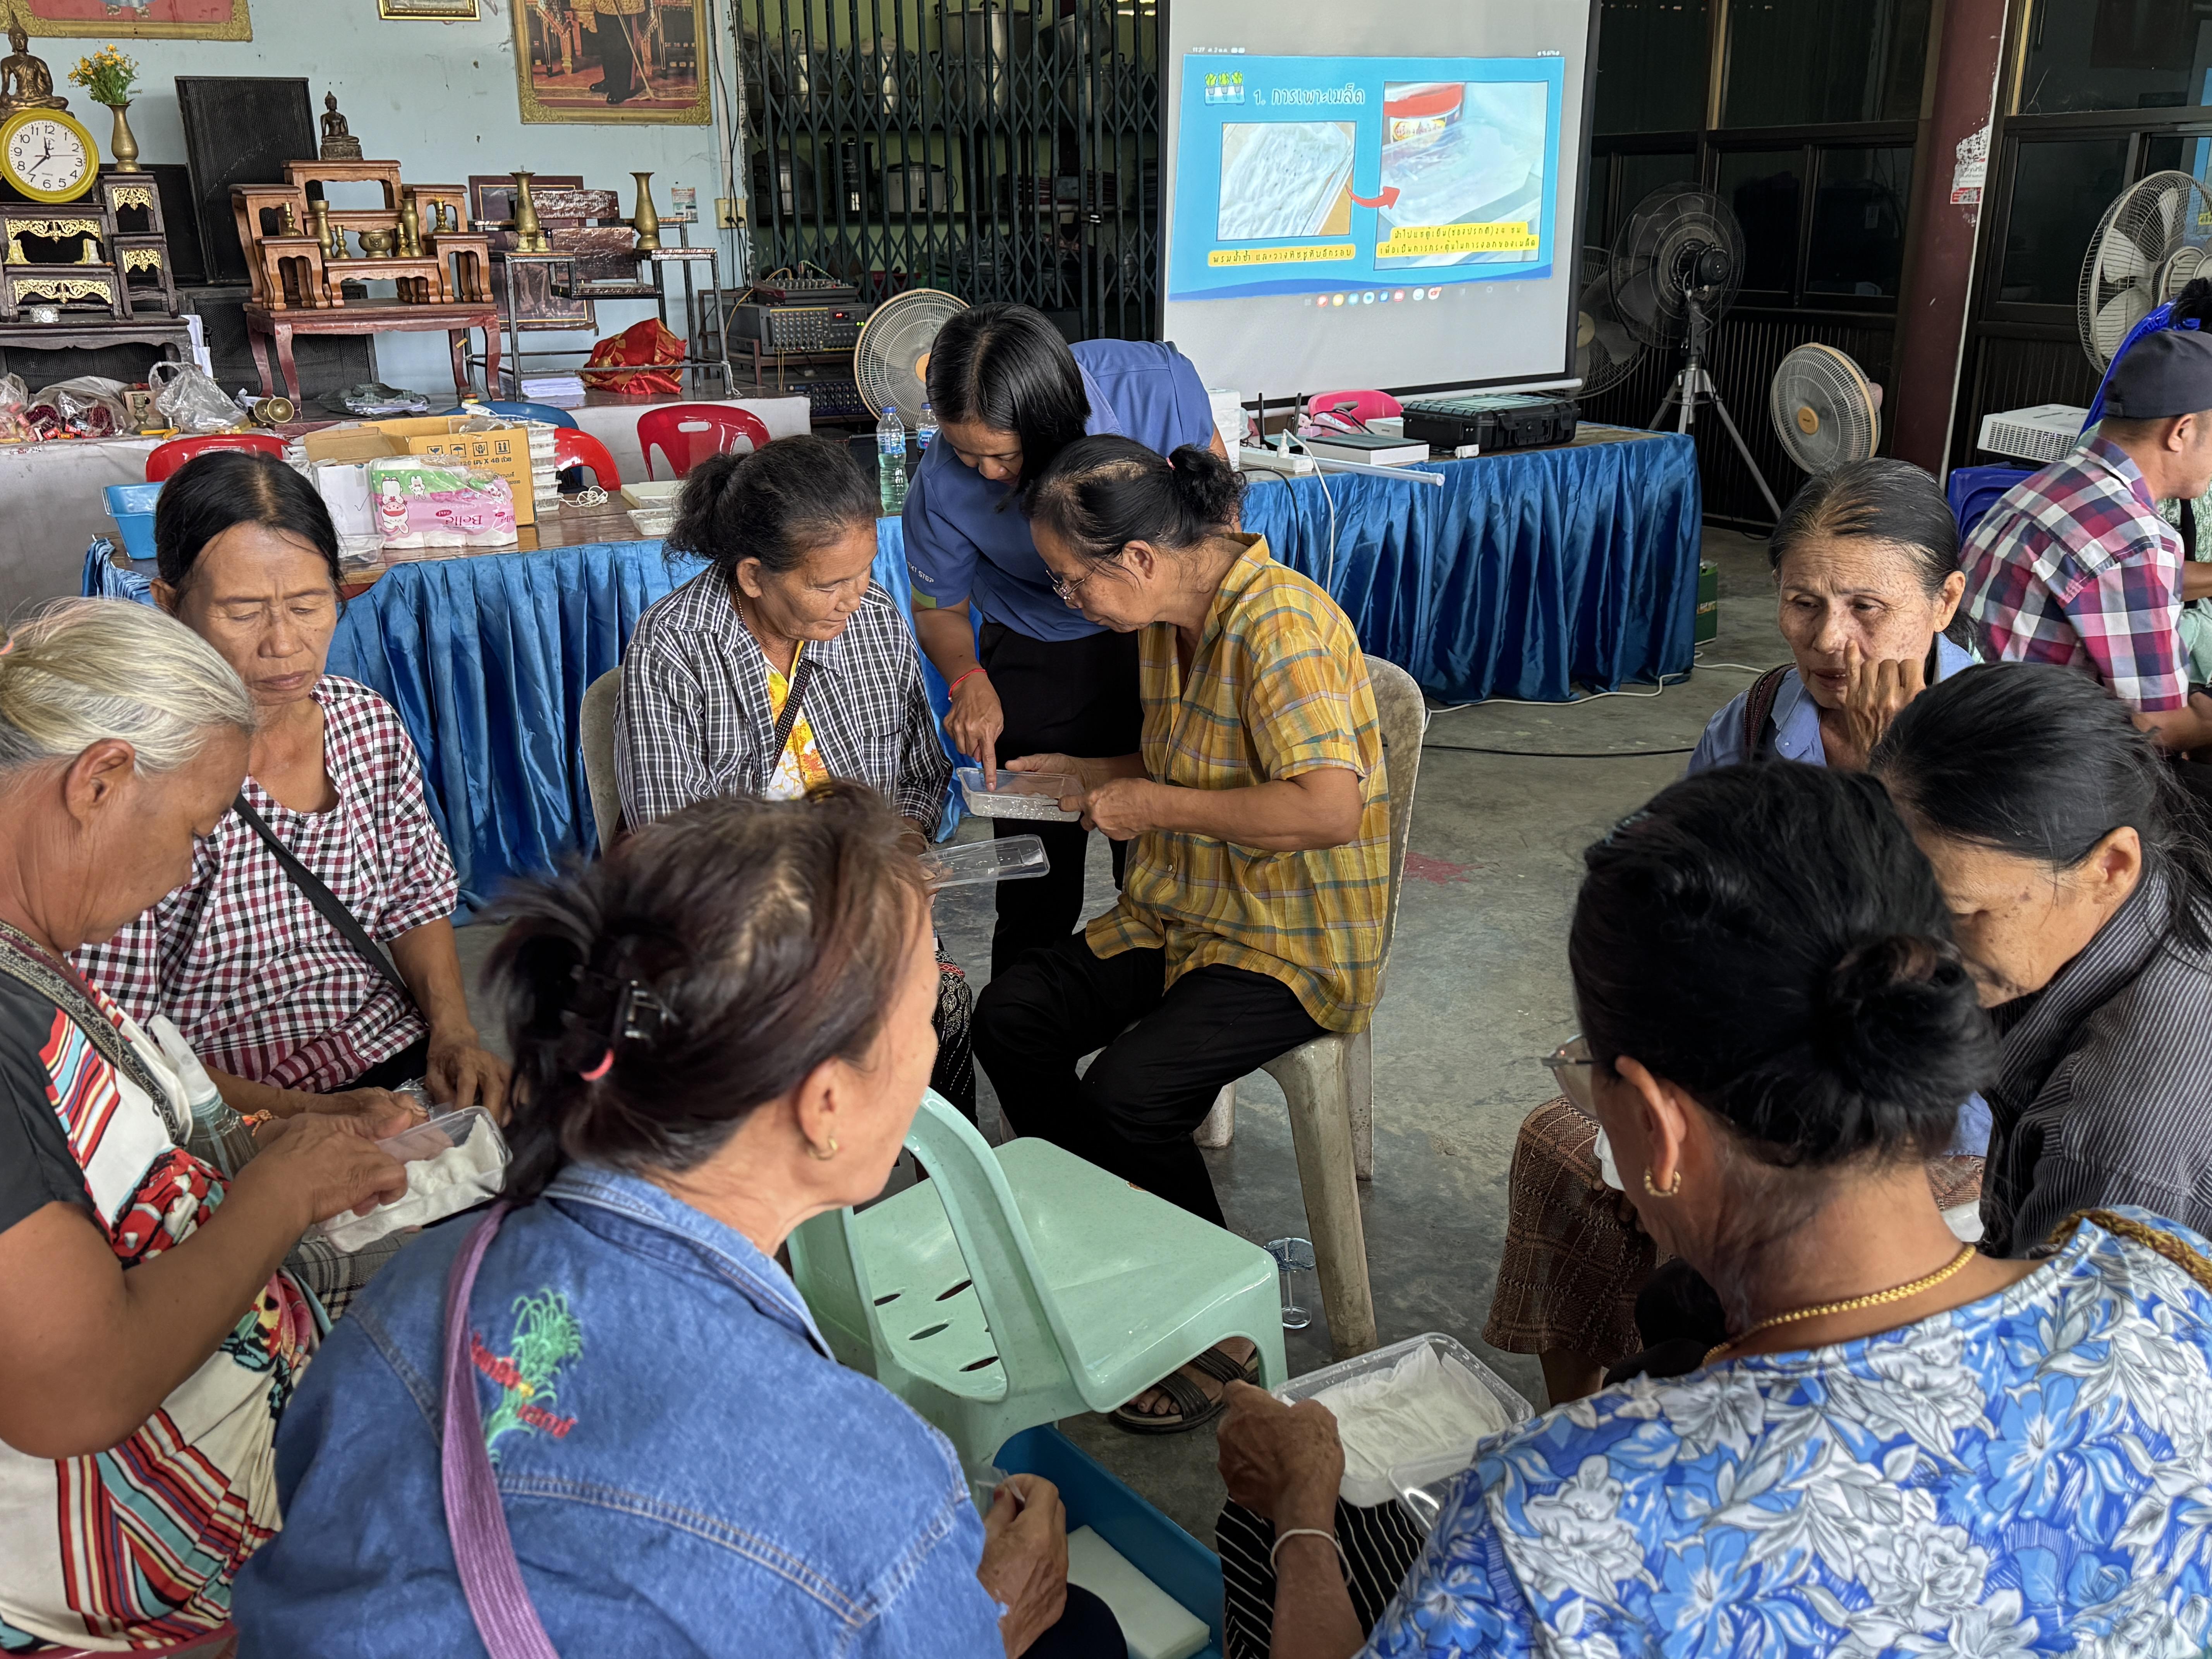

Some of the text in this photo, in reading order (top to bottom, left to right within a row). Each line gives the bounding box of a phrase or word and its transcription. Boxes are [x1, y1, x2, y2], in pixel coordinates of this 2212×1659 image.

[1254, 83, 1365, 105] 1. การเพาะเมล็ด
[31, 126, 39, 136] 11
[45, 125, 55, 134] 12
[20, 134, 30, 143] 10
[65, 132, 67, 141] 1
[14, 147, 22, 156] 9
[72, 143, 79, 152] 2
[17, 161, 25, 171] 8
[75, 158, 83, 167] 3
[28, 173, 36, 182] 7
[70, 170, 77, 179] 4
[43, 179, 51, 188] 6
[58, 178, 66, 187] 5
[918, 570, 934, 583] STEP
